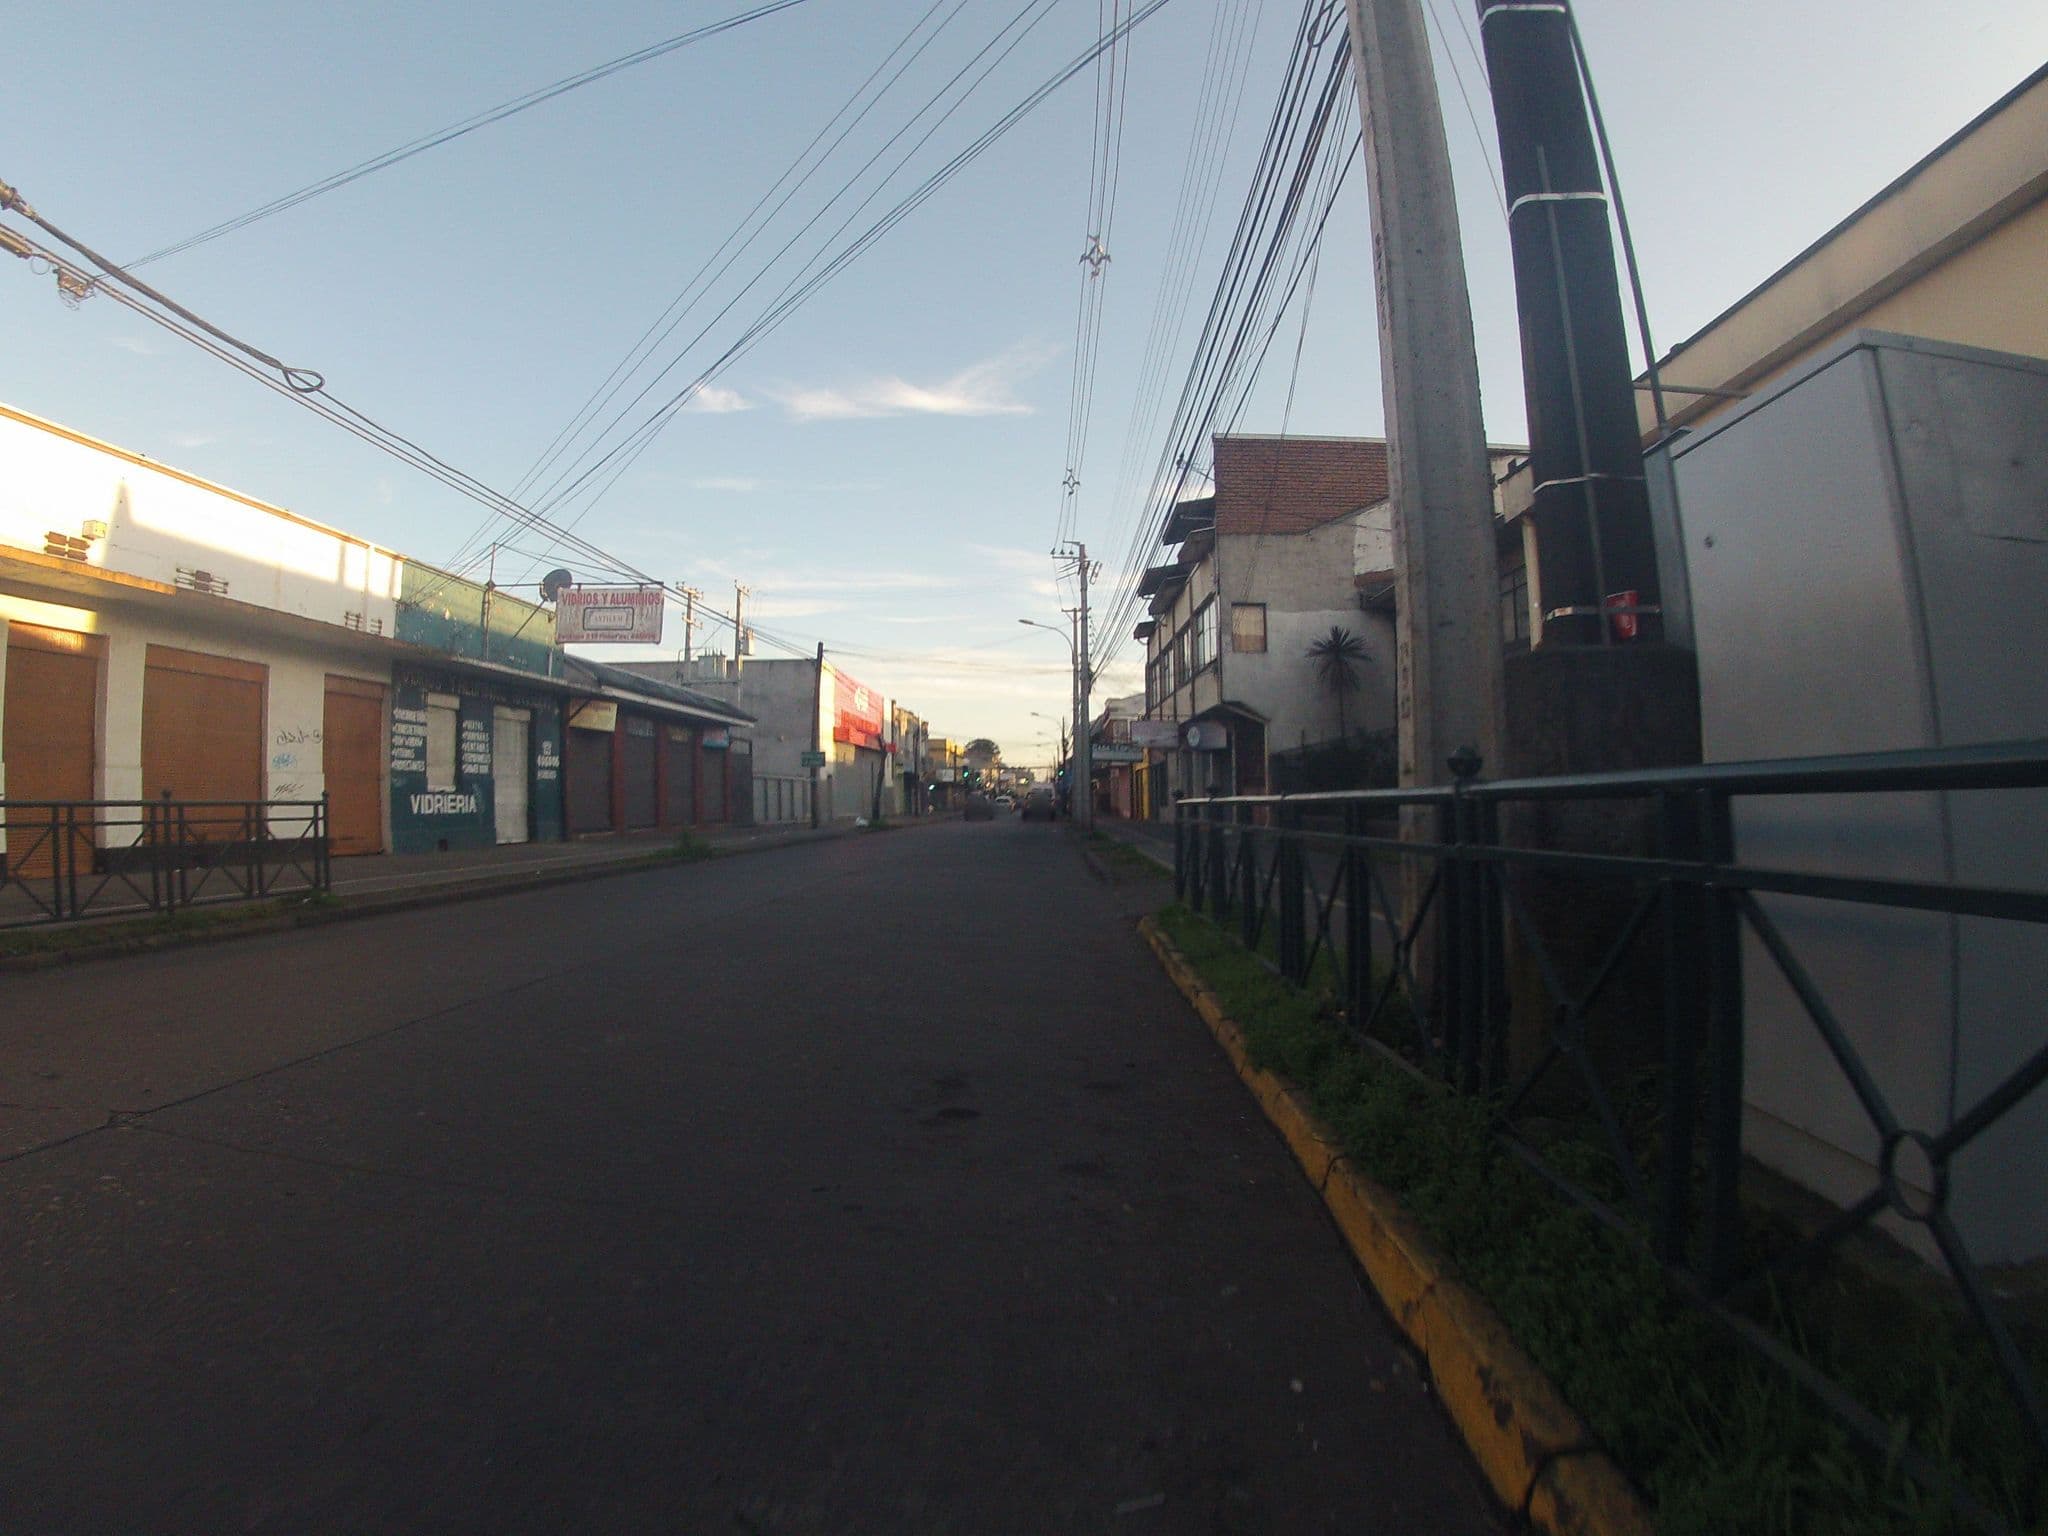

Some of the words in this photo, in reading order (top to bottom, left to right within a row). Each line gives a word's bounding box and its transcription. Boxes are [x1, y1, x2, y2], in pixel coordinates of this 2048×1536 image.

[561, 592, 598, 606] VIDRIOS
[602, 592, 609, 606] Y
[610, 592, 661, 606] ALUMINIOS
[410, 794, 477, 815] VIDRIERIA
